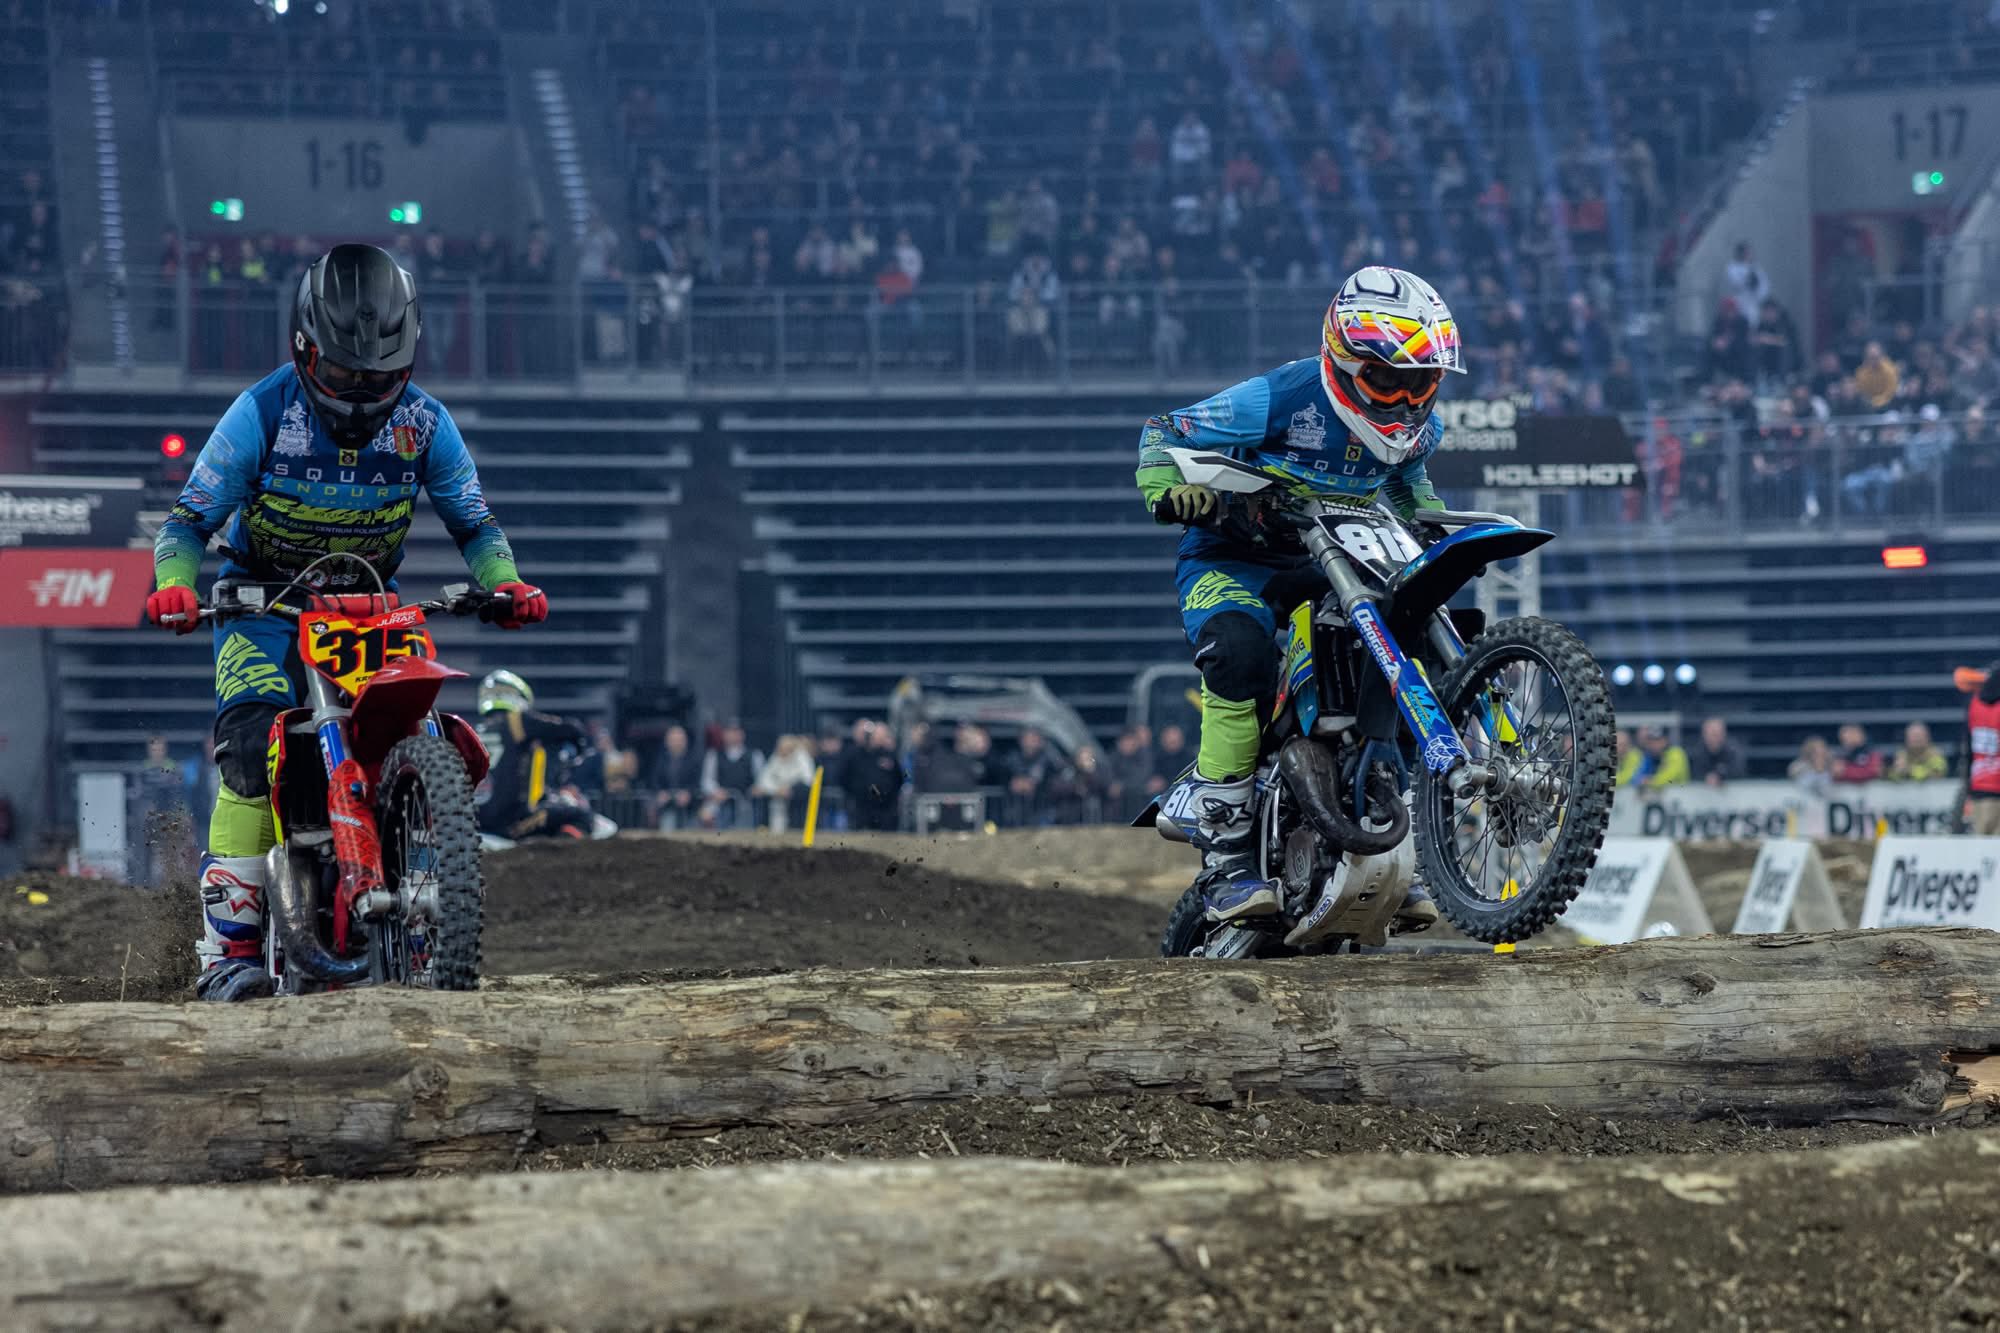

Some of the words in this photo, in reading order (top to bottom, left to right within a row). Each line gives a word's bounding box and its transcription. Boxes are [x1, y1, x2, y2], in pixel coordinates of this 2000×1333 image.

[1890, 105, 1969, 161] 1-17
[305, 138, 384, 191] 1-16
[272, 477, 413, 498] ENDURO
[274, 463, 415, 485] SQUAD
[1483, 463, 1637, 486] HOLESHOT
[0, 490, 90, 521] iverse
[27, 567, 114, 607] FIM
[376, 615, 416, 627] JURAK
[316, 628, 427, 678] 315
[1409, 684, 1447, 725] MX
[1643, 802, 1786, 836] Diverse
[1885, 856, 1978, 912] Diverse
